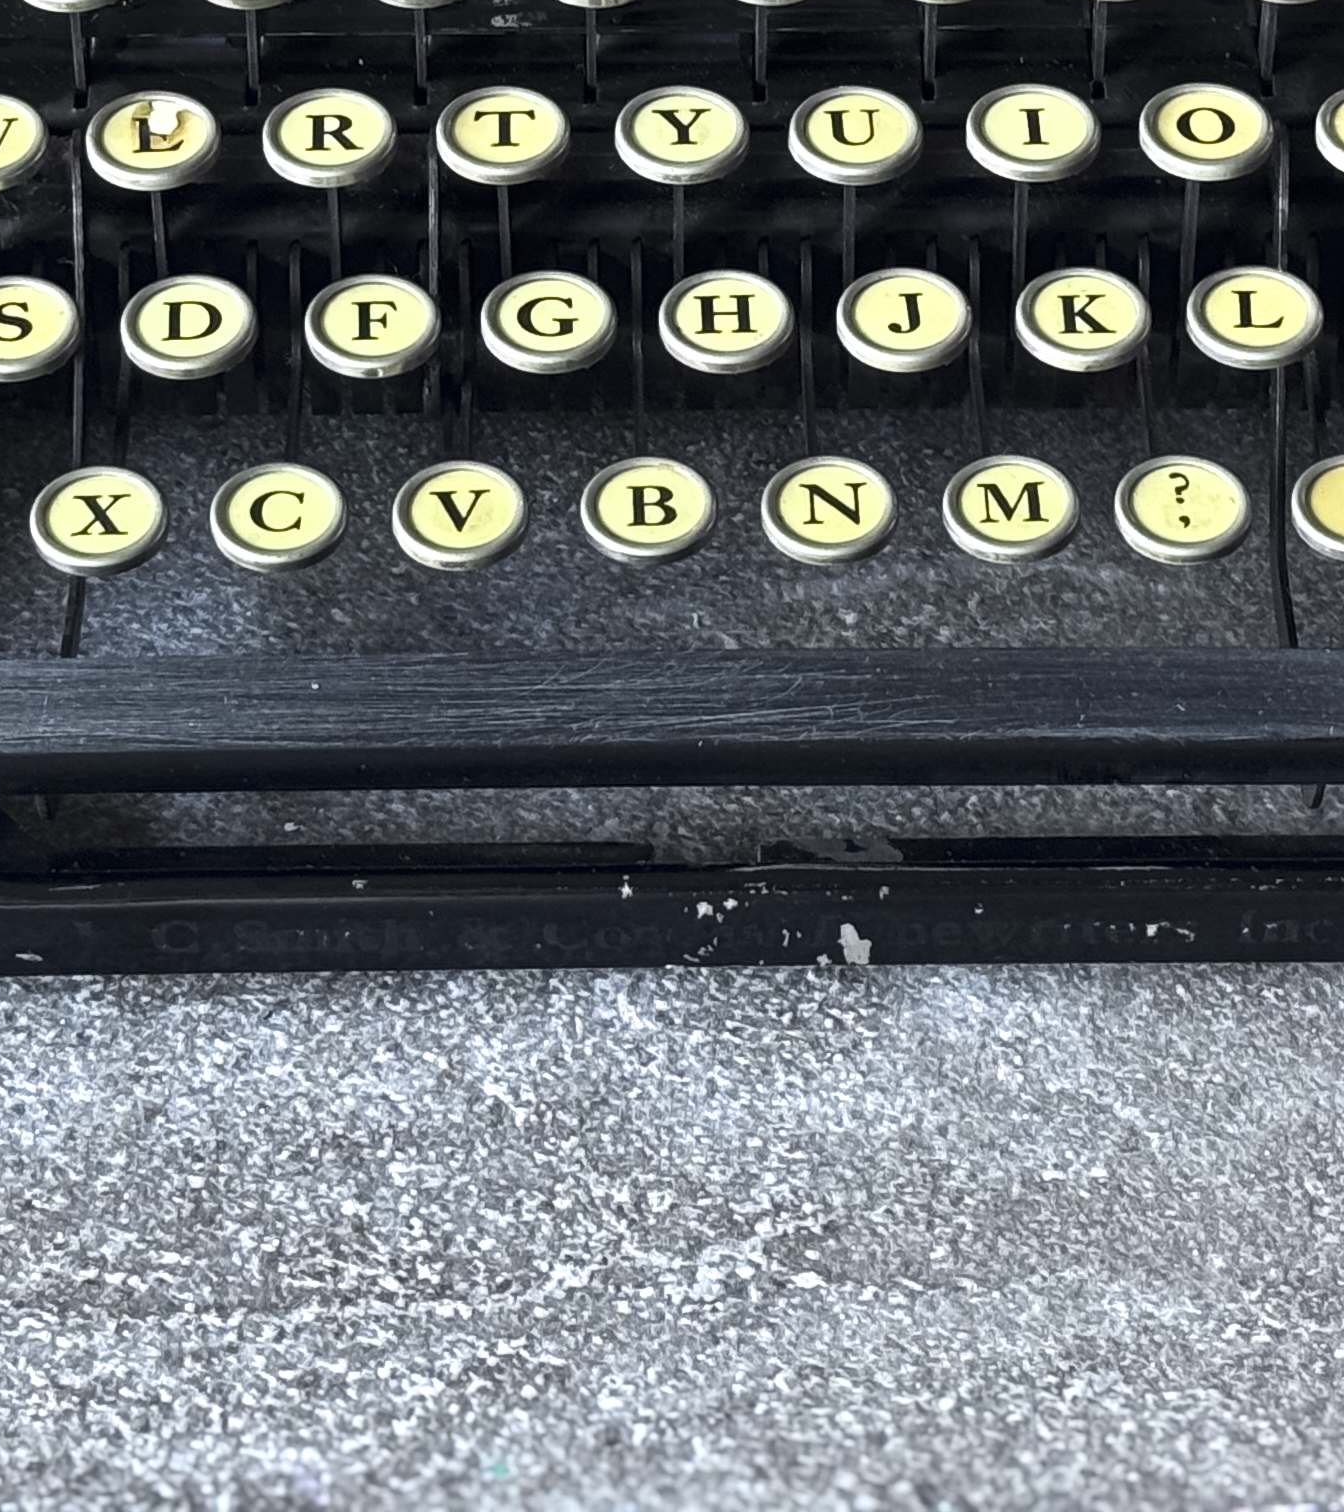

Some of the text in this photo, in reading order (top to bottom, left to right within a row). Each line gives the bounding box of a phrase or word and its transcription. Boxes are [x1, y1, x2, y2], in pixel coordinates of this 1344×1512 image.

[305, 114, 364, 152] R
[473, 109, 536, 148] T
[651, 107, 712, 146] Y
[822, 108, 880, 147] U
[1019, 108, 1049, 146] I
[1176, 107, 1236, 145] O
[162, 300, 223, 342] D
[351, 300, 398, 341] F
[516, 296, 579, 338] G
[693, 294, 758, 335] H
[887, 292, 923, 334] J
[1057, 294, 1117, 335] K
[1231, 290, 1284, 329] L
[627, 485, 678, 527] B
[799, 482, 867, 526] N
[976, 481, 1050, 524] M
[1168, 472, 1190, 505] ?
[69, 493, 131, 538] X
[249, 490, 305, 533] C
[429, 489, 491, 533] V
